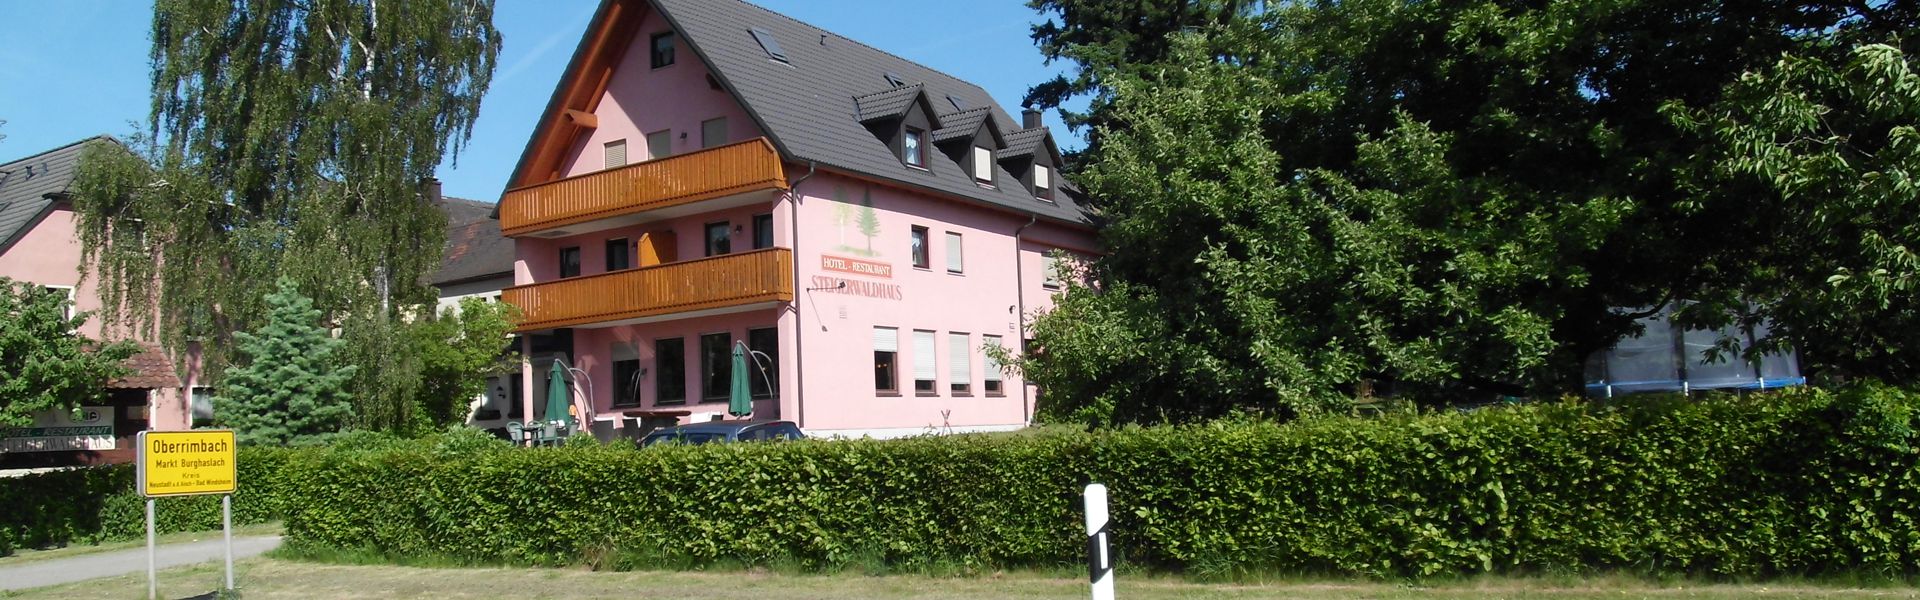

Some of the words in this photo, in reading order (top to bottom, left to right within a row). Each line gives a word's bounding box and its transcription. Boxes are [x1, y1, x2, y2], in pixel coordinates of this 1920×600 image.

[823, 257, 847, 270] HOTEL
[852, 261, 890, 276] RESTAURANT
[811, 274, 903, 301] STEIGERWALDHAUS
[1, 427, 33, 437] OTEL
[153, 439, 228, 453] Oberrimbach
[155, 459, 178, 468] Markt
[181, 458, 225, 469] Burghaslach
